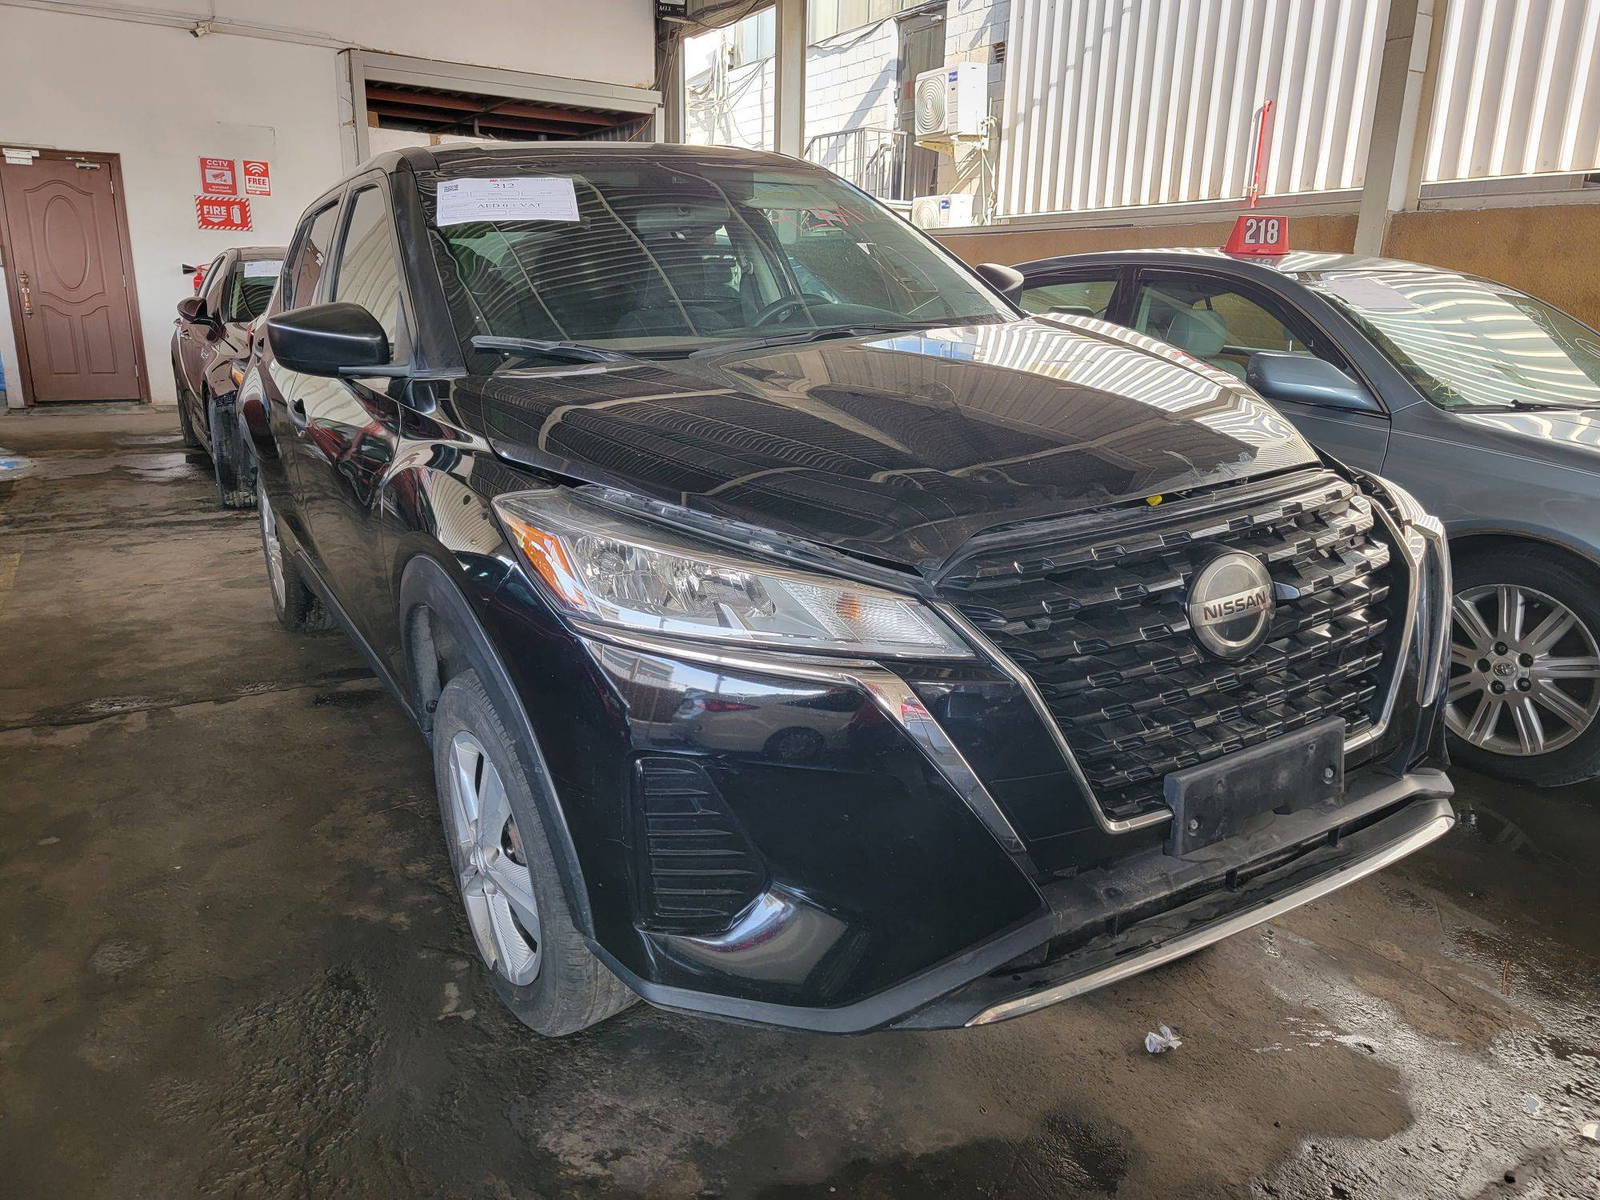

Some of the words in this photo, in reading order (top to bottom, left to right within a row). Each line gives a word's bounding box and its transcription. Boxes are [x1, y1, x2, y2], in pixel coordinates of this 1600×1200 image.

[247, 177, 267, 186] FREE
[203, 205, 227, 216] FIRE
[1245, 218, 1279, 244] 218
[1203, 591, 1267, 621] NISSAN
